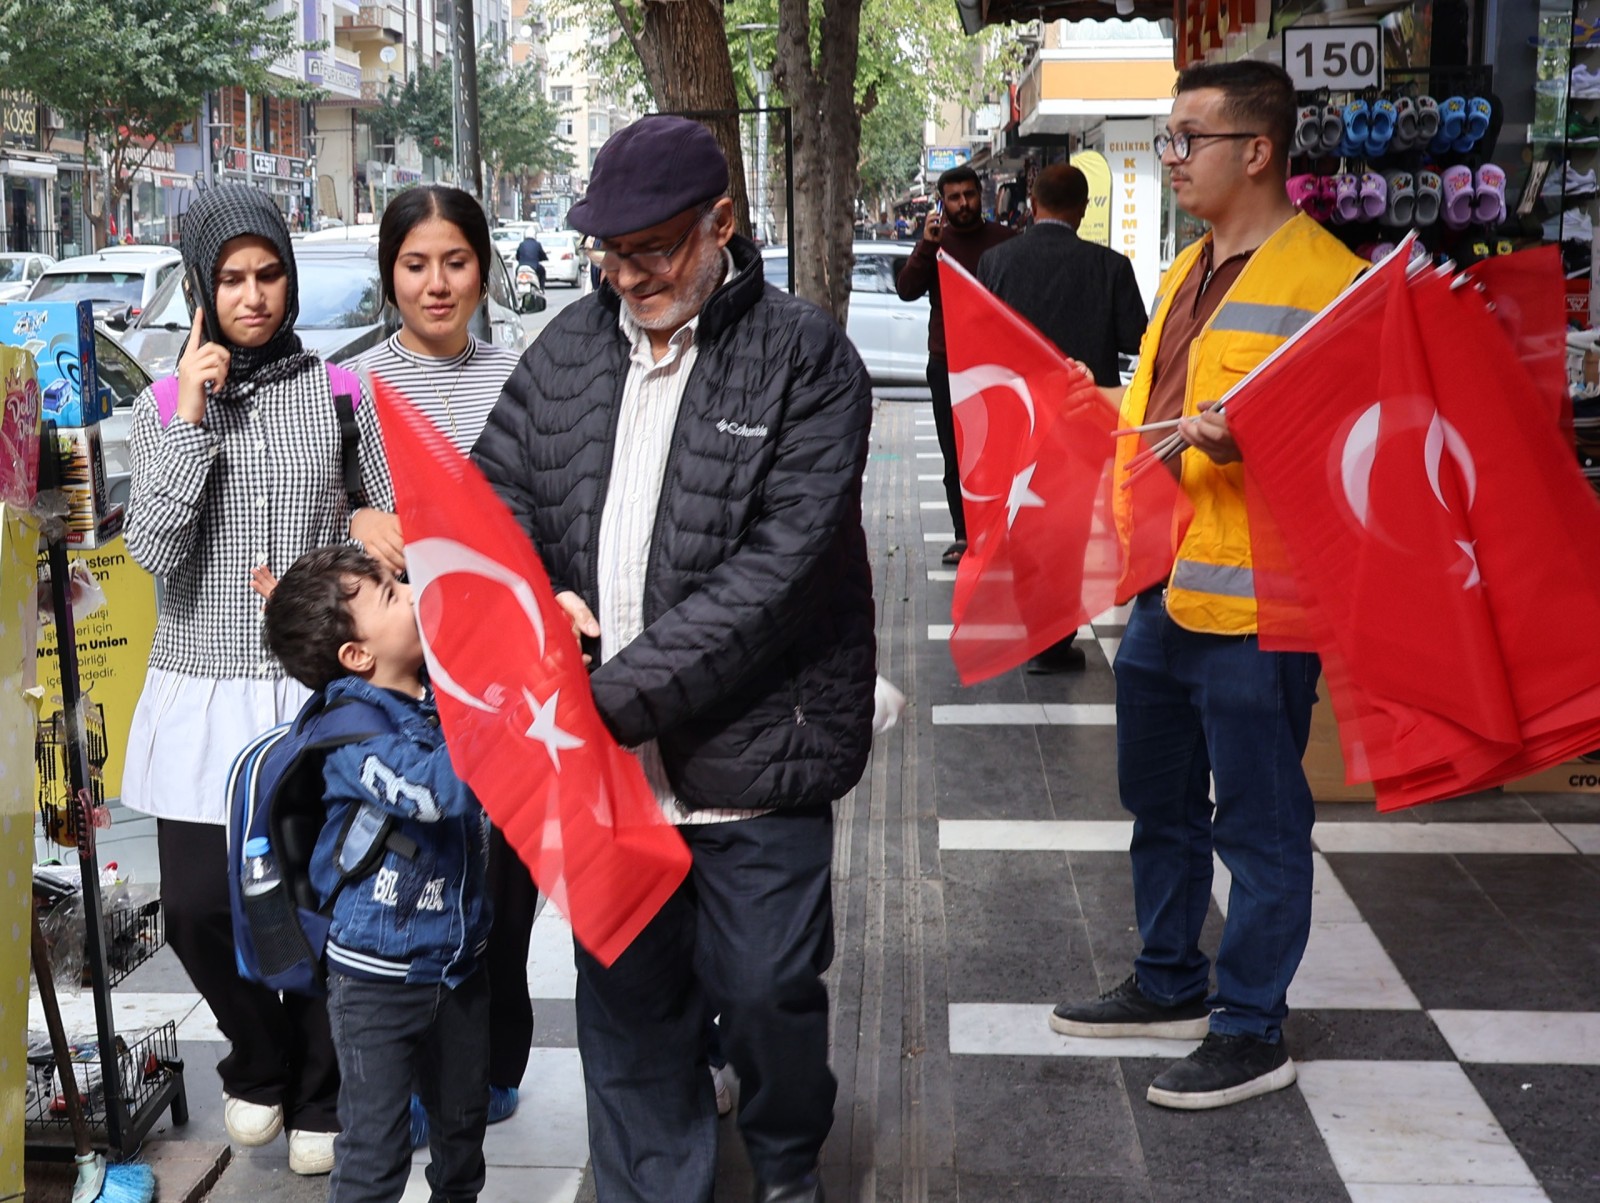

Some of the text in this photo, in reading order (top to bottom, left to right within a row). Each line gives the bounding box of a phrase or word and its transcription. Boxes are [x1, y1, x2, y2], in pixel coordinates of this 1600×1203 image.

[1296, 41, 1374, 78] 150
[1109, 141, 1151, 152] ÇELİKTAŞ
[1122, 158, 1137, 259] KUYUMCU
[7, 383, 38, 424] Dolly
[90, 636, 128, 650] Union
[1568, 774, 1600, 787] cro
